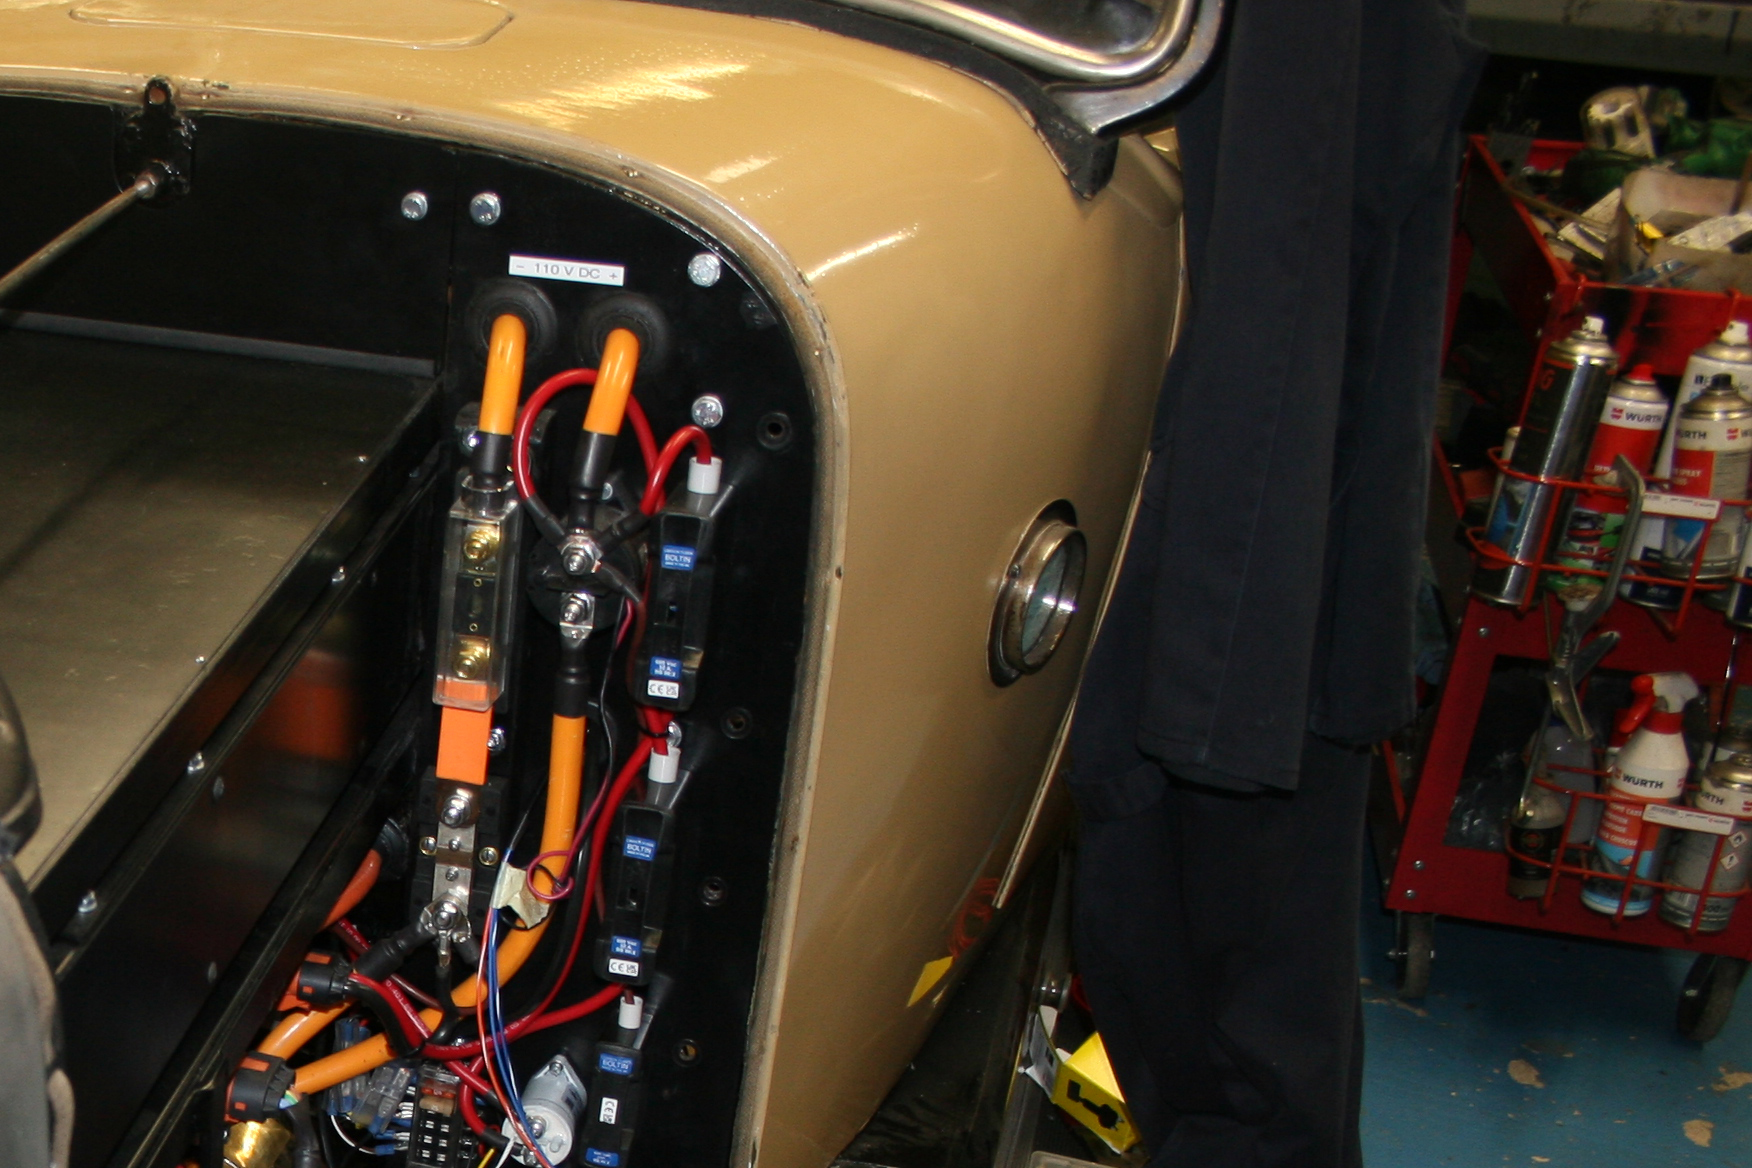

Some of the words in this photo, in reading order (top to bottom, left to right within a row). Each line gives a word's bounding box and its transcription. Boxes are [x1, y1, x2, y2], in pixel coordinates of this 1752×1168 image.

[534, 262, 559, 275] 110
[564, 266, 574, 276] V
[579, 267, 601, 279] DC
